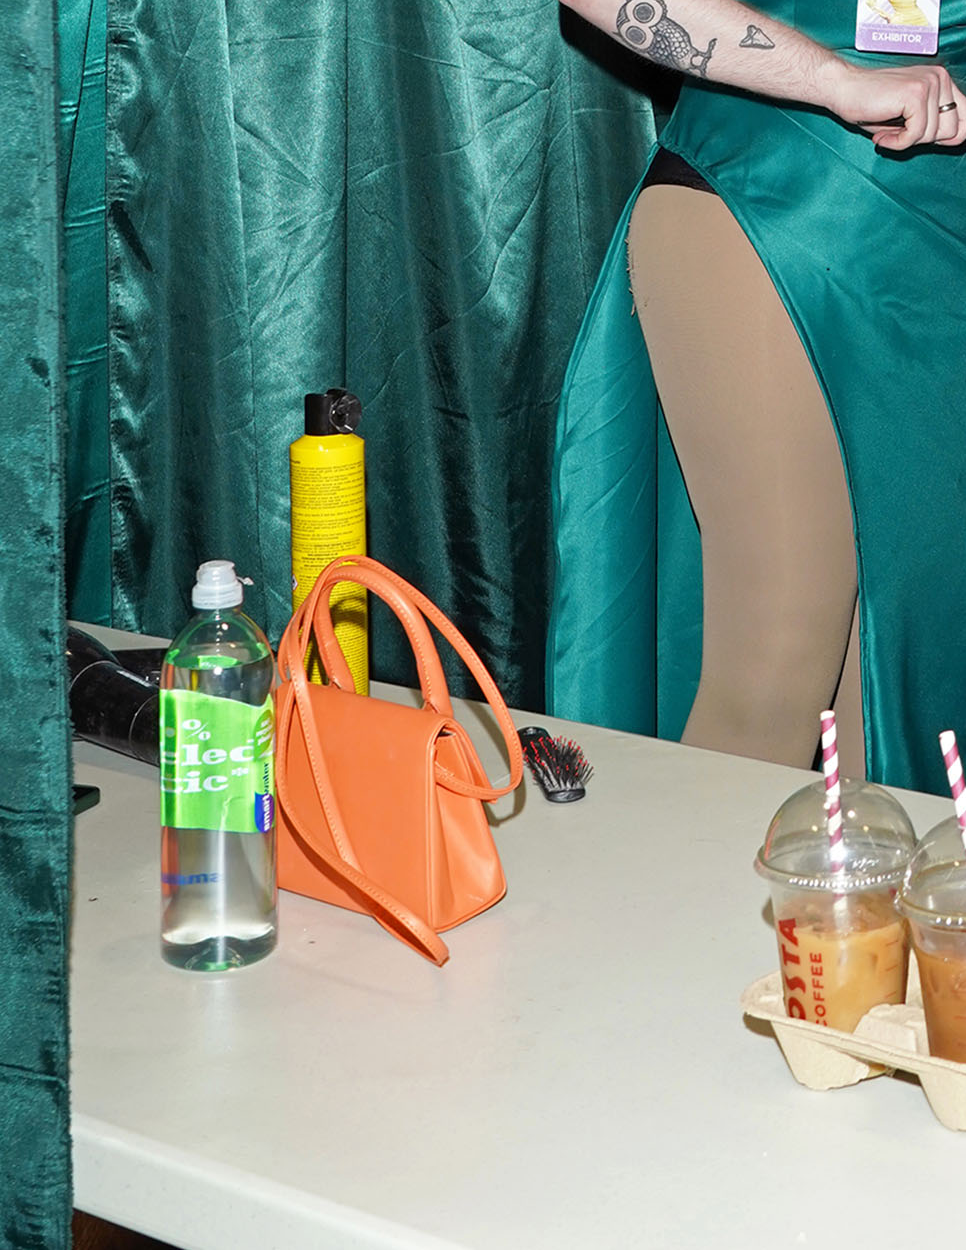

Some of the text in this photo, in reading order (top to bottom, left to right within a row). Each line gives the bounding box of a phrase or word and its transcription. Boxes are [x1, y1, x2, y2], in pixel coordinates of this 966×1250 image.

[872, 32, 922, 43] EXHIBITOR
[778, 917, 807, 1021] OSTA
[809, 952, 828, 1027] OFFEE
